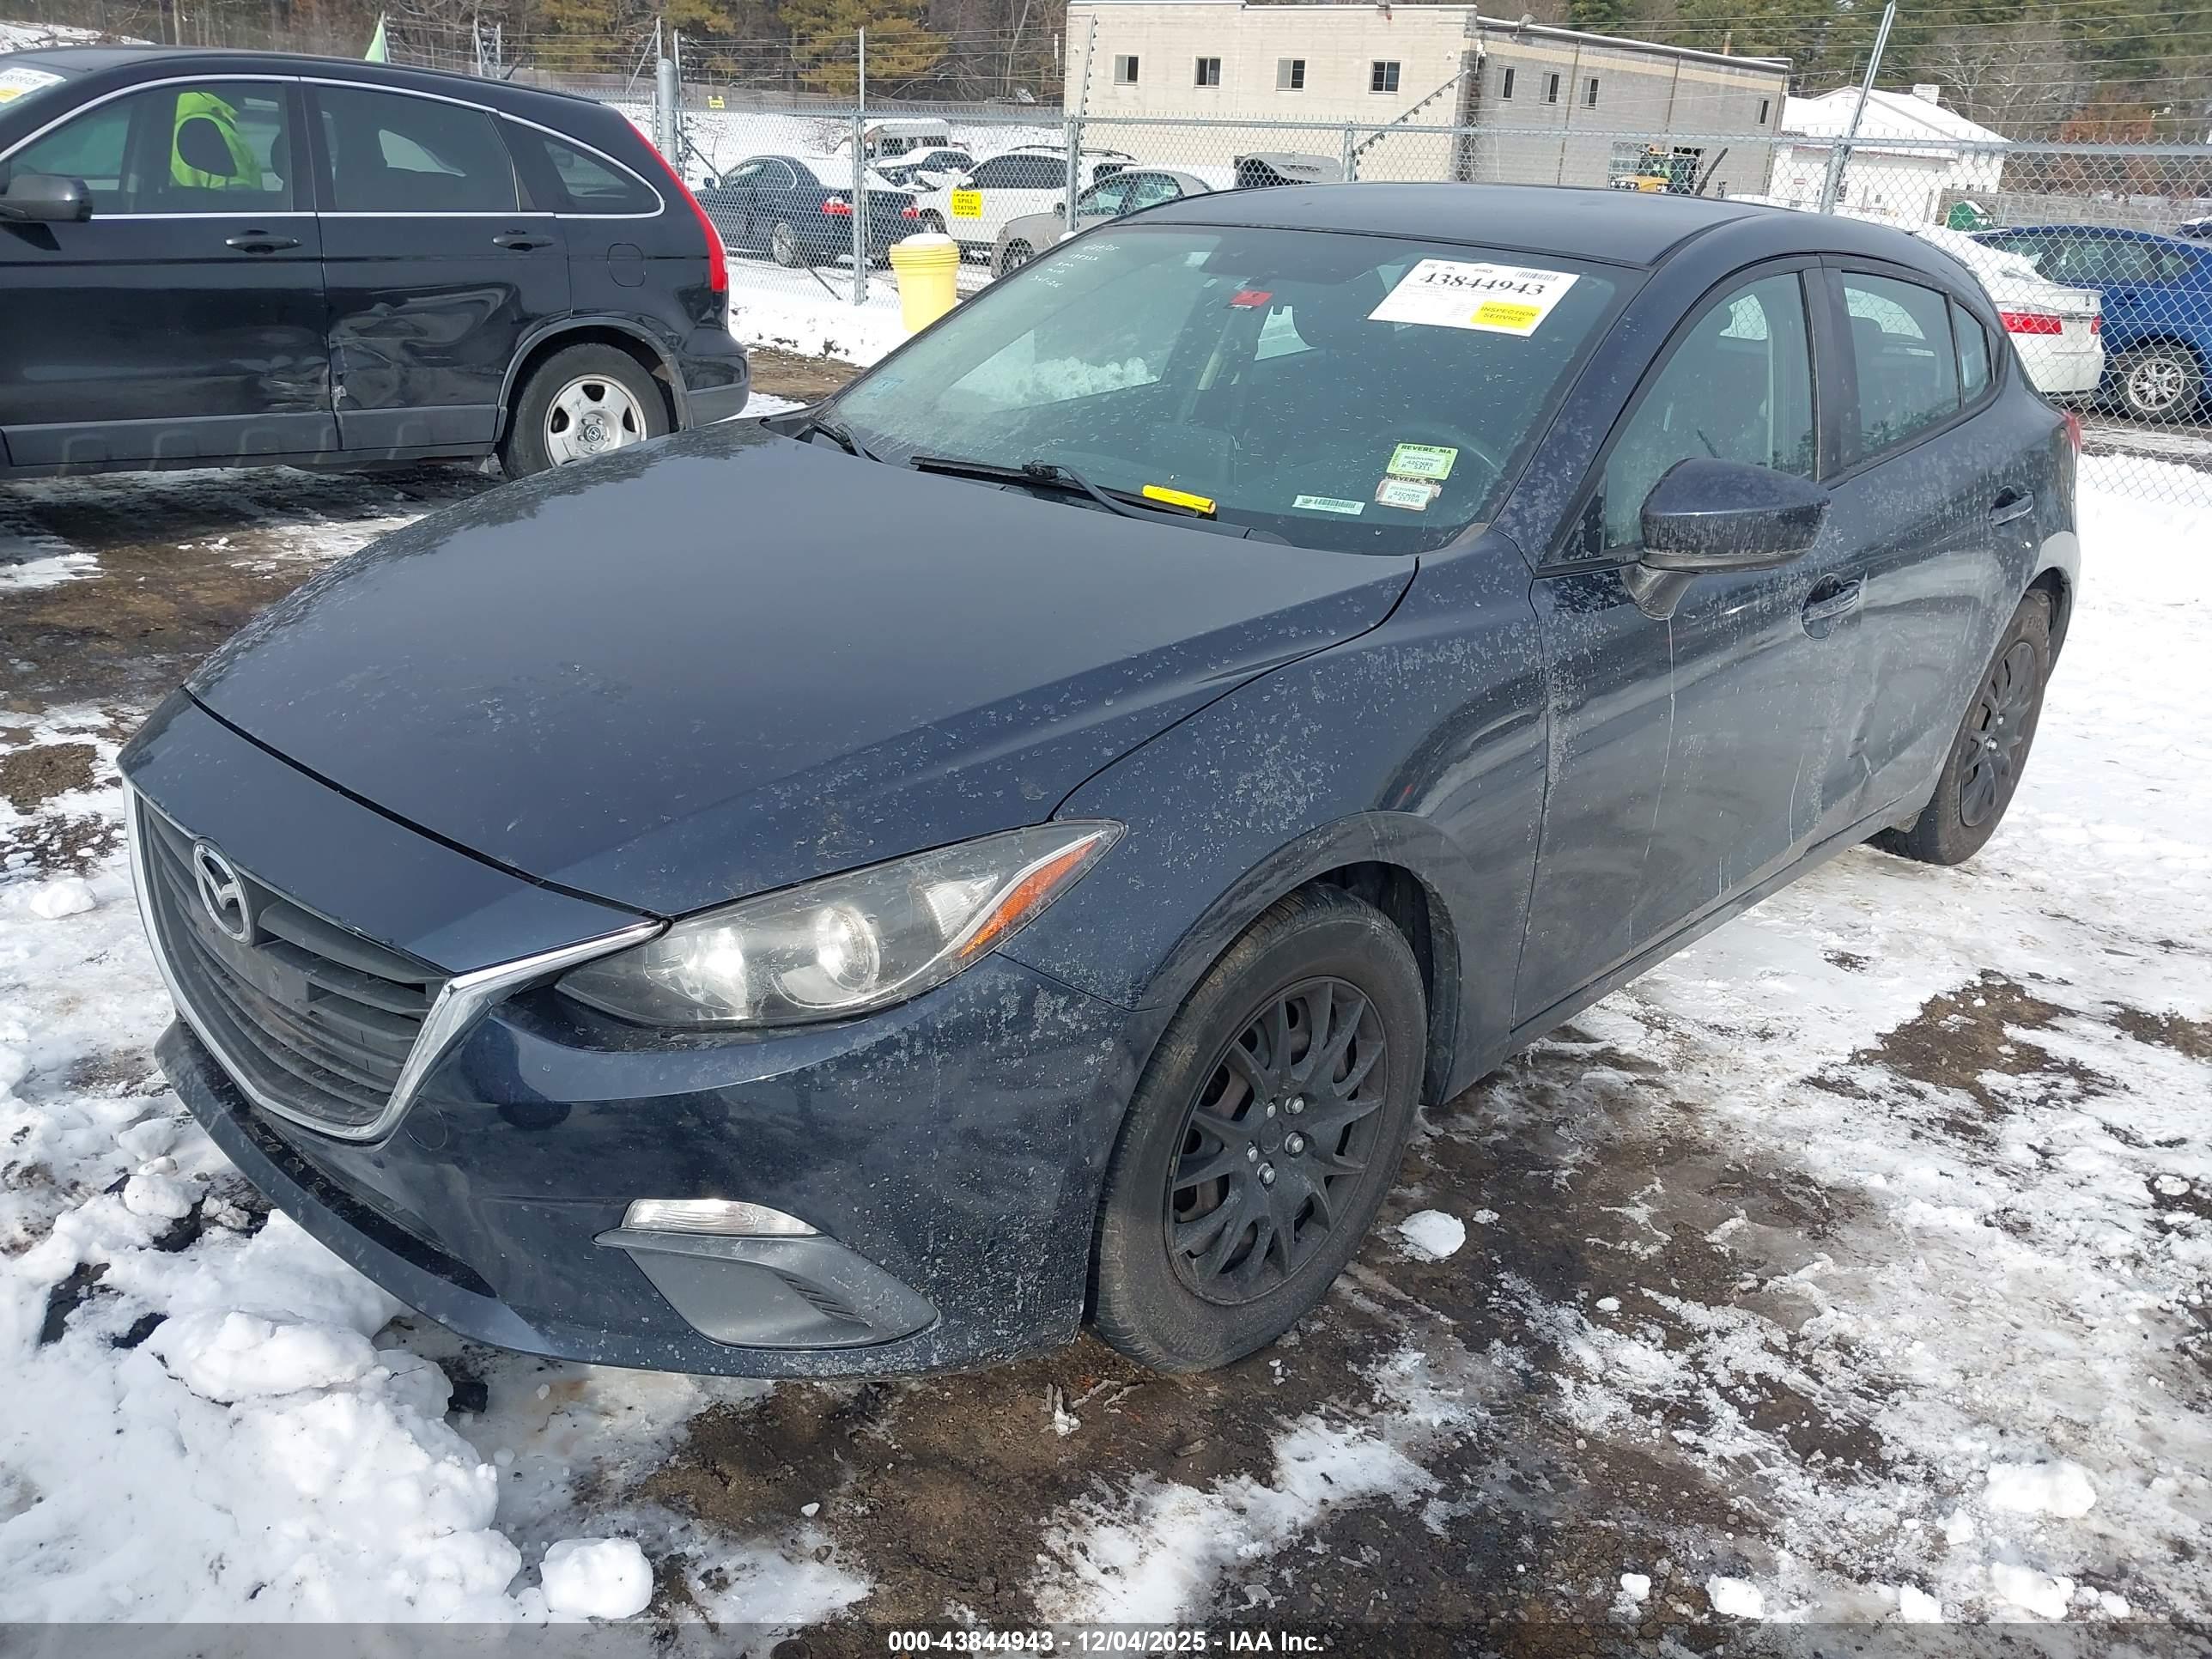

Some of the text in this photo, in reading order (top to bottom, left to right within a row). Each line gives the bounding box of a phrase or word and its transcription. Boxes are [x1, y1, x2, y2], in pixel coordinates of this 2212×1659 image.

[1419, 271, 1546, 295] 43844943
[1480, 307, 1536, 317] INSPECTION
[1484, 313, 1526, 322] SERVICE
[1401, 445, 1436, 453] REVERE,
